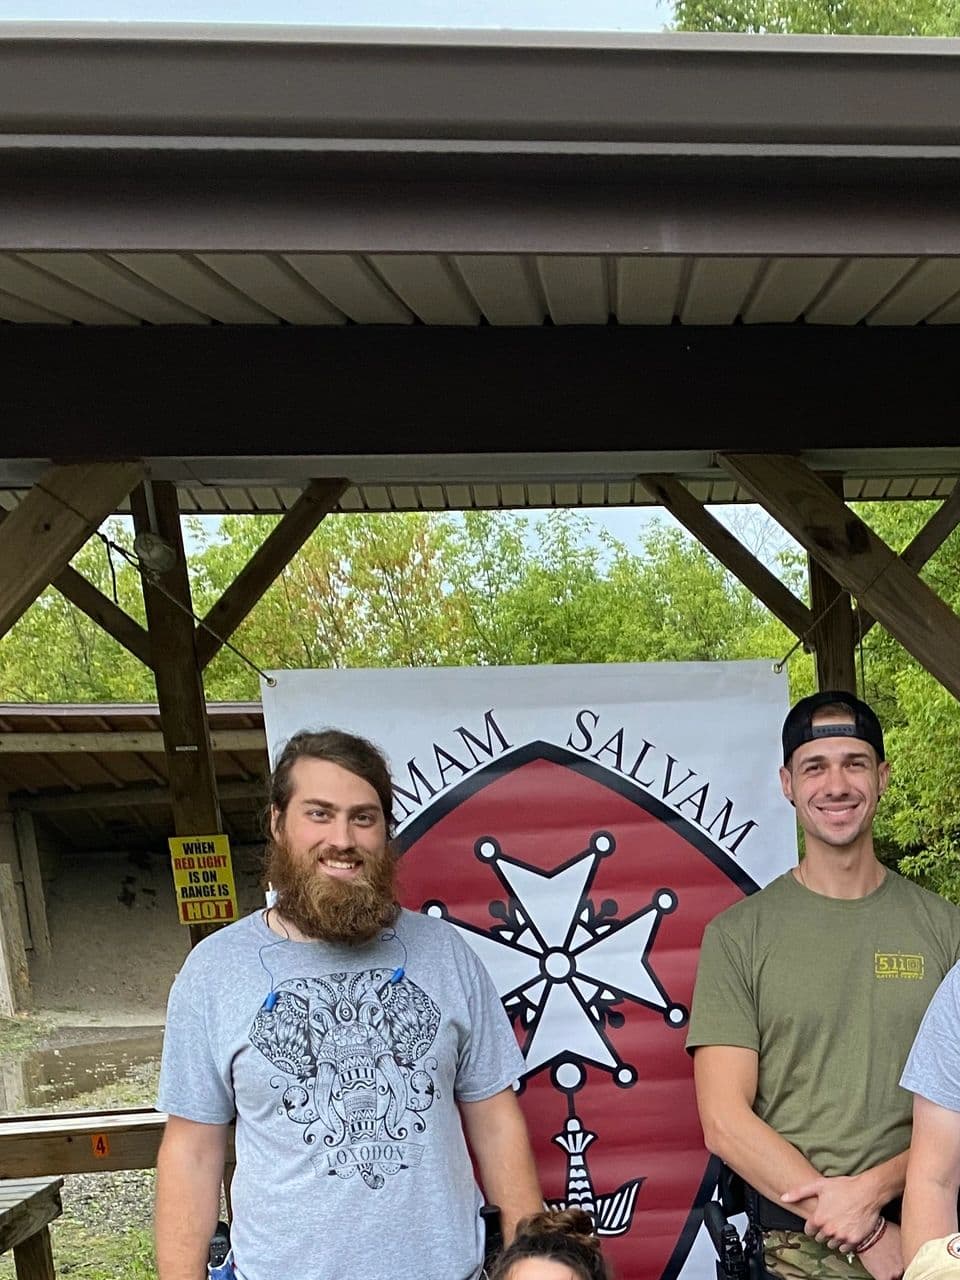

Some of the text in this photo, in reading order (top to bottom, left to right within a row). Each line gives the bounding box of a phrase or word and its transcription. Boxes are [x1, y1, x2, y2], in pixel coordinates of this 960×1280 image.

[392, 708, 759, 857] MAM SALVAM
[182, 841, 215, 855] WHEN
[174, 855, 227, 870] RED LIGHT
[189, 870, 217, 883] IS ON
[181, 884, 229, 898] RANGE IS
[187, 901, 228, 920] HOT
